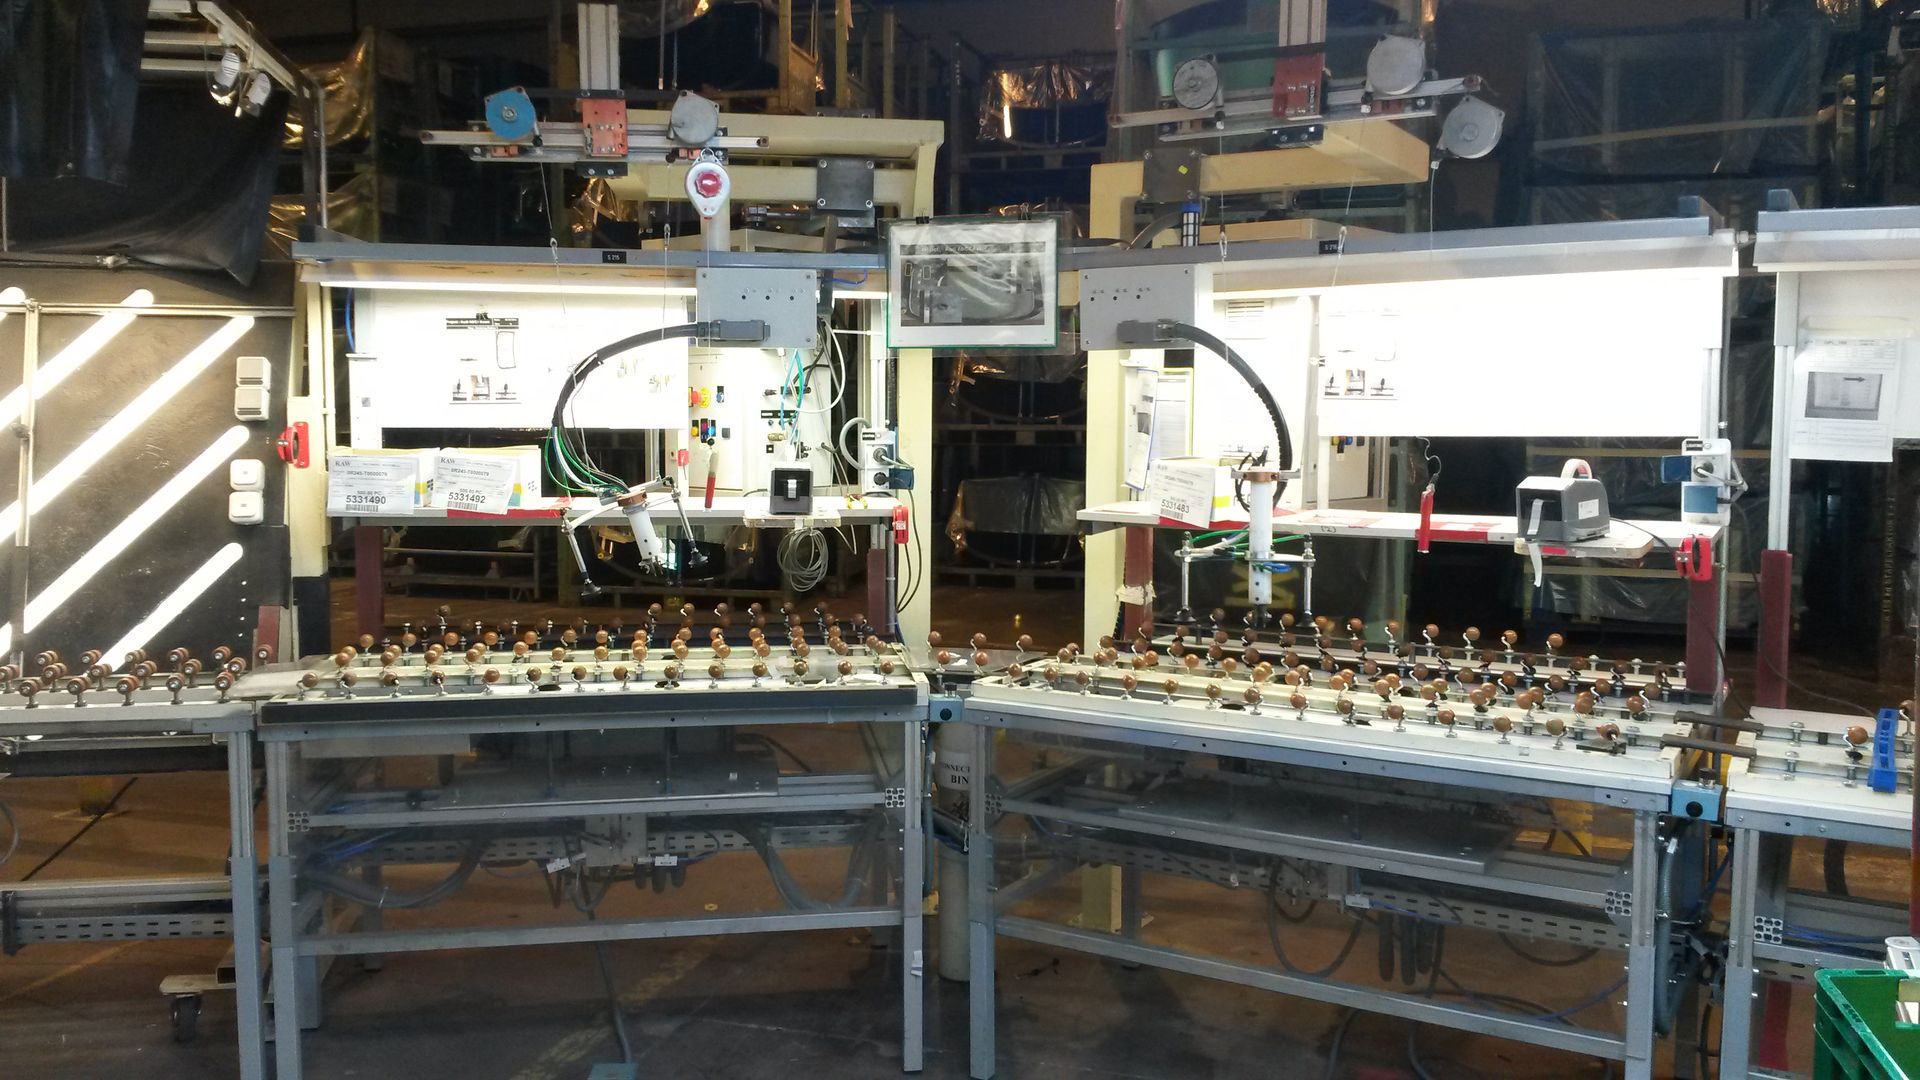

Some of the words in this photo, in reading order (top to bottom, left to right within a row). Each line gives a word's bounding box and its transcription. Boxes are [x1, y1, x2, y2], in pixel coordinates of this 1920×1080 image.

[345, 495, 386, 504] 5331490
[448, 492, 486, 504] 5331492
[1161, 499, 1190, 513] 5331483
[951, 775, 969, 784] BIN
